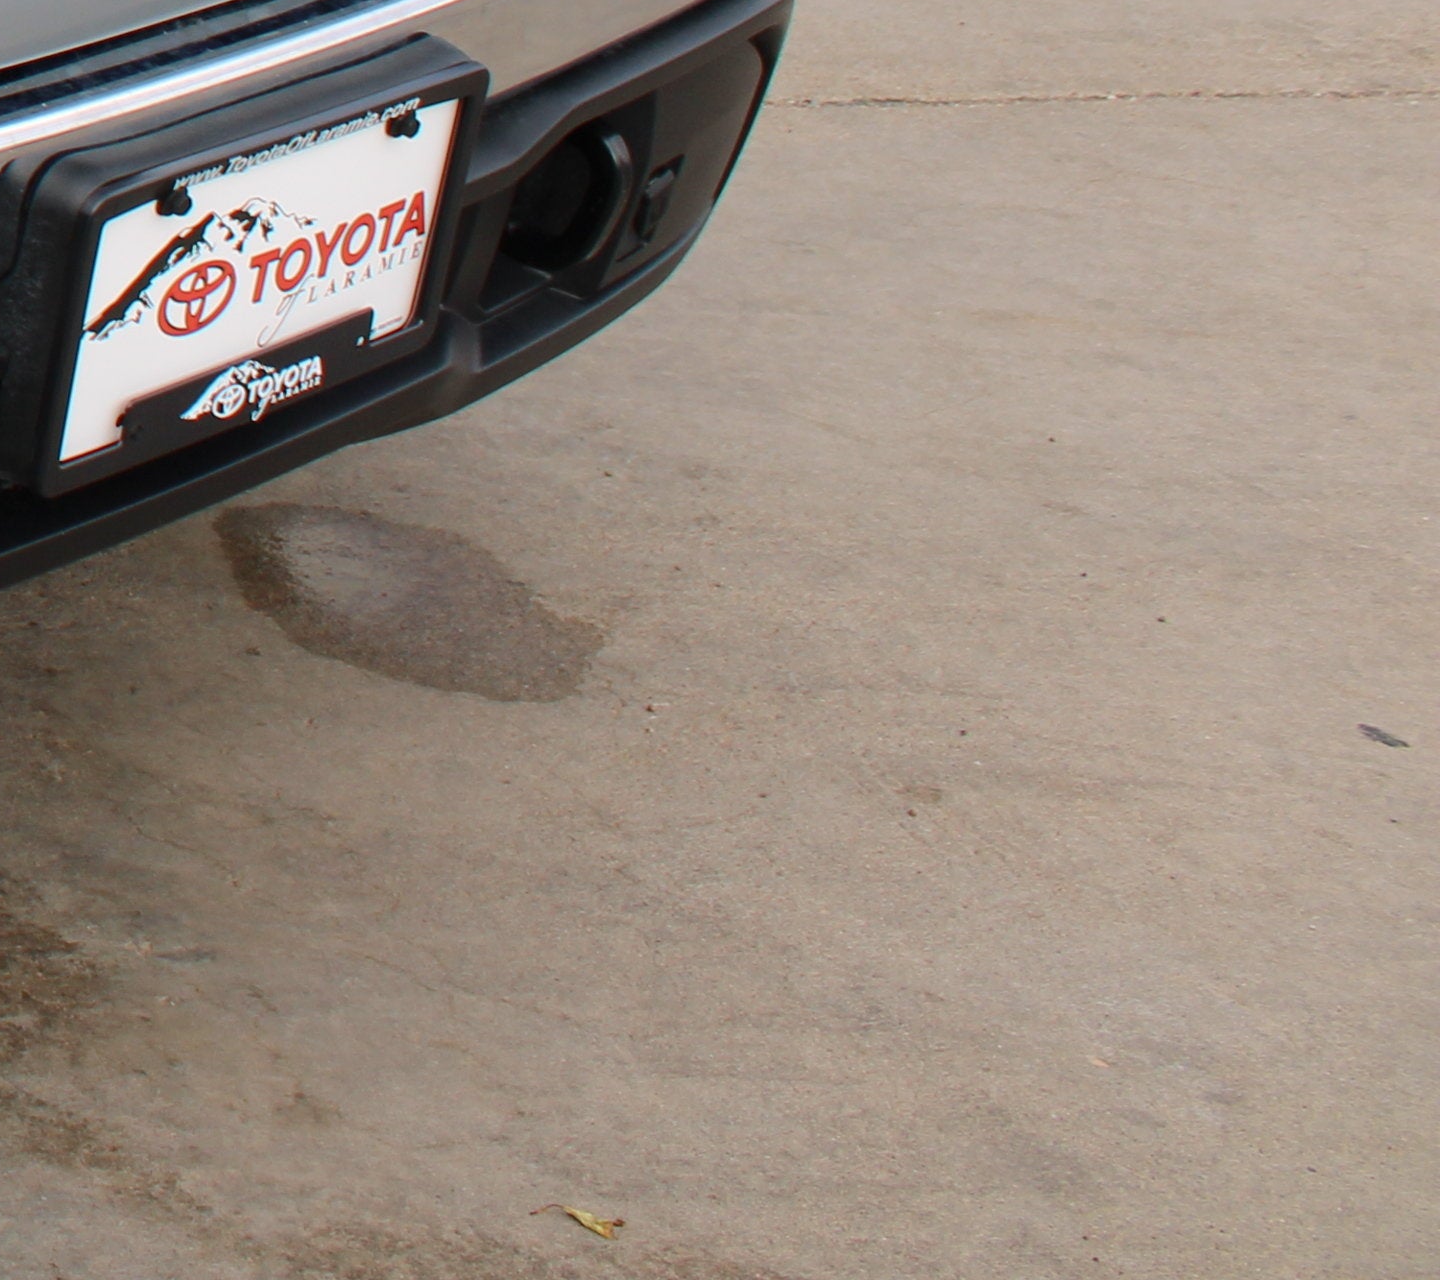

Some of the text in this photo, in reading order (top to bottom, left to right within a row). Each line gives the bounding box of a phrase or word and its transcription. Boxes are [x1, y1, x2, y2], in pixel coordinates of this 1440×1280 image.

[249, 190, 426, 304] TOYOTA
[306, 240, 424, 304] LARAMIE
[247, 355, 323, 404] TOYOTA
